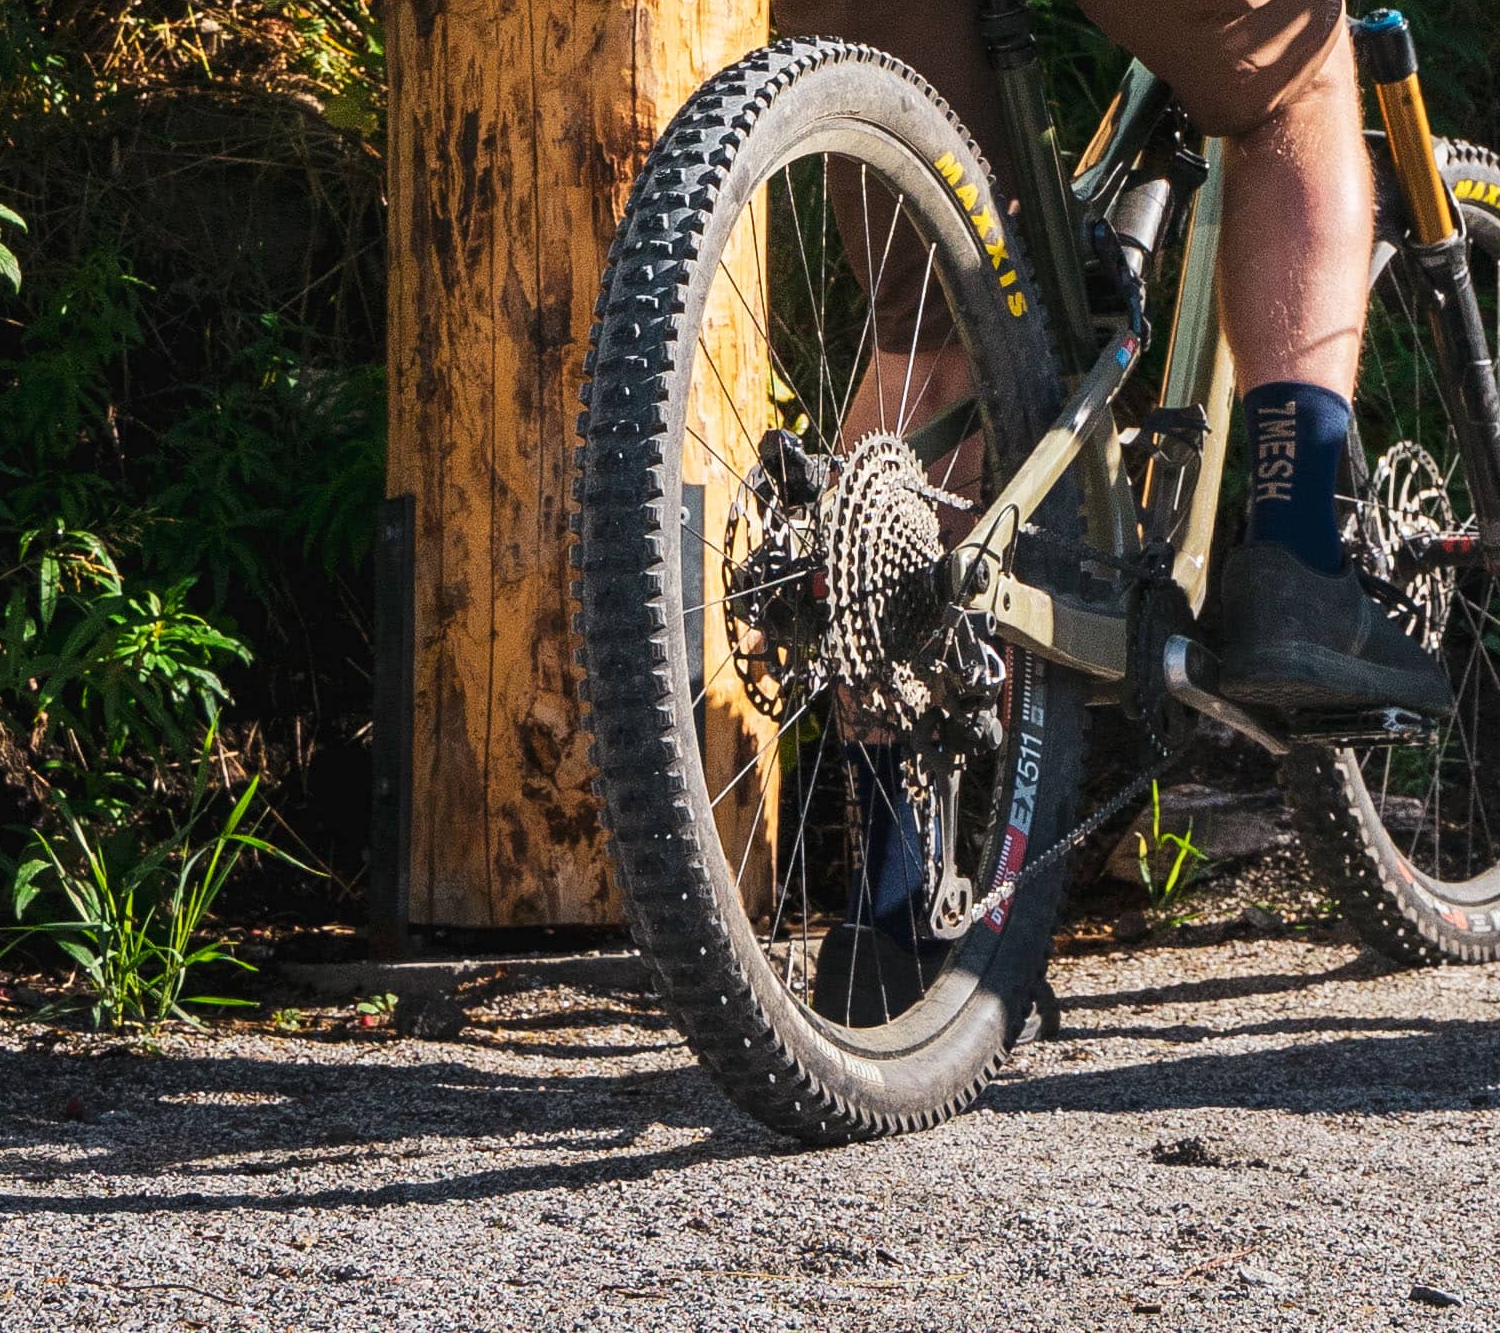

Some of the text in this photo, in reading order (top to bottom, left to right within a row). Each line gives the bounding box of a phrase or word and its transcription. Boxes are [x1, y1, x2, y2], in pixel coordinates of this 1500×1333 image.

[934, 150, 1028, 318] MAXXIS
[1256, 401, 1296, 502] 7MESH
[1008, 731, 1043, 836] EX511
